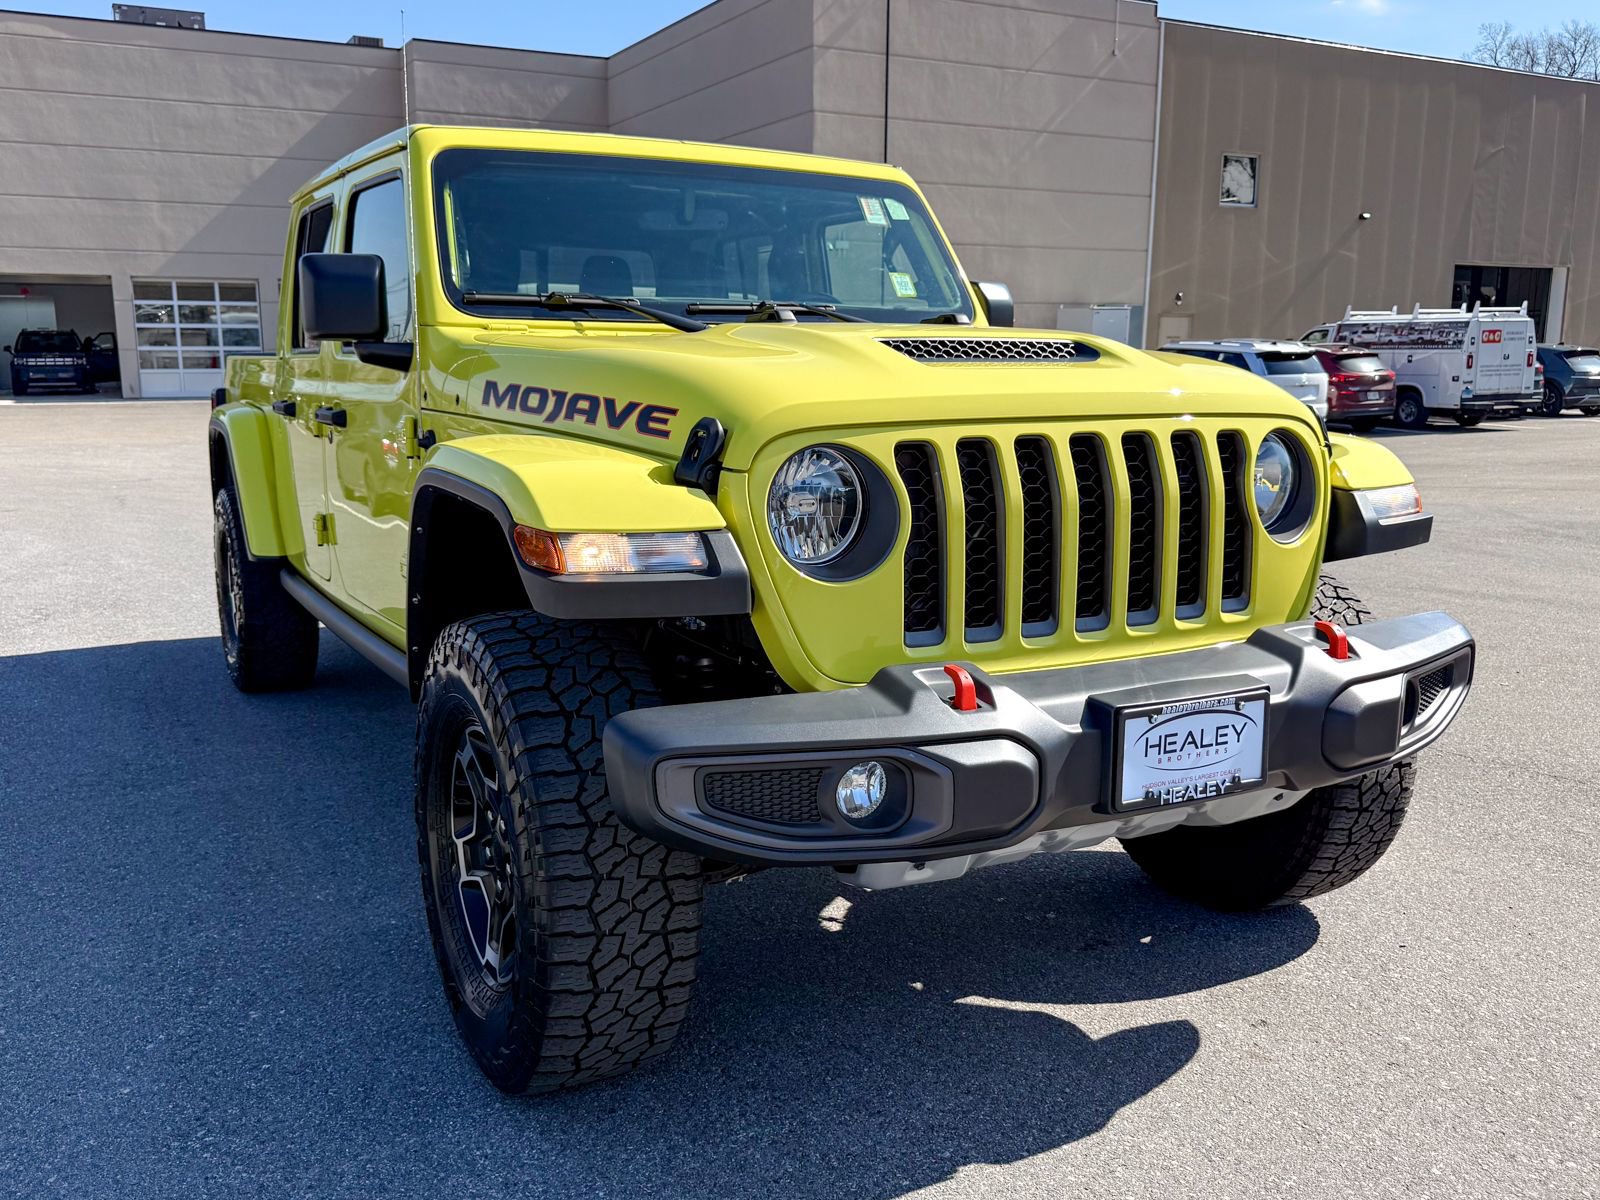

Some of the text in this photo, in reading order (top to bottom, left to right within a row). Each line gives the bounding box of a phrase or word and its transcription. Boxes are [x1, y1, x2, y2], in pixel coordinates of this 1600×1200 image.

[481, 380, 680, 440] MOJAVE
[1144, 721, 1248, 758] HEALEY
[1157, 748, 1229, 765] BROTHERS
[1194, 772, 1219, 782] LARGEST
[1159, 778, 1229, 806] HEALEY
